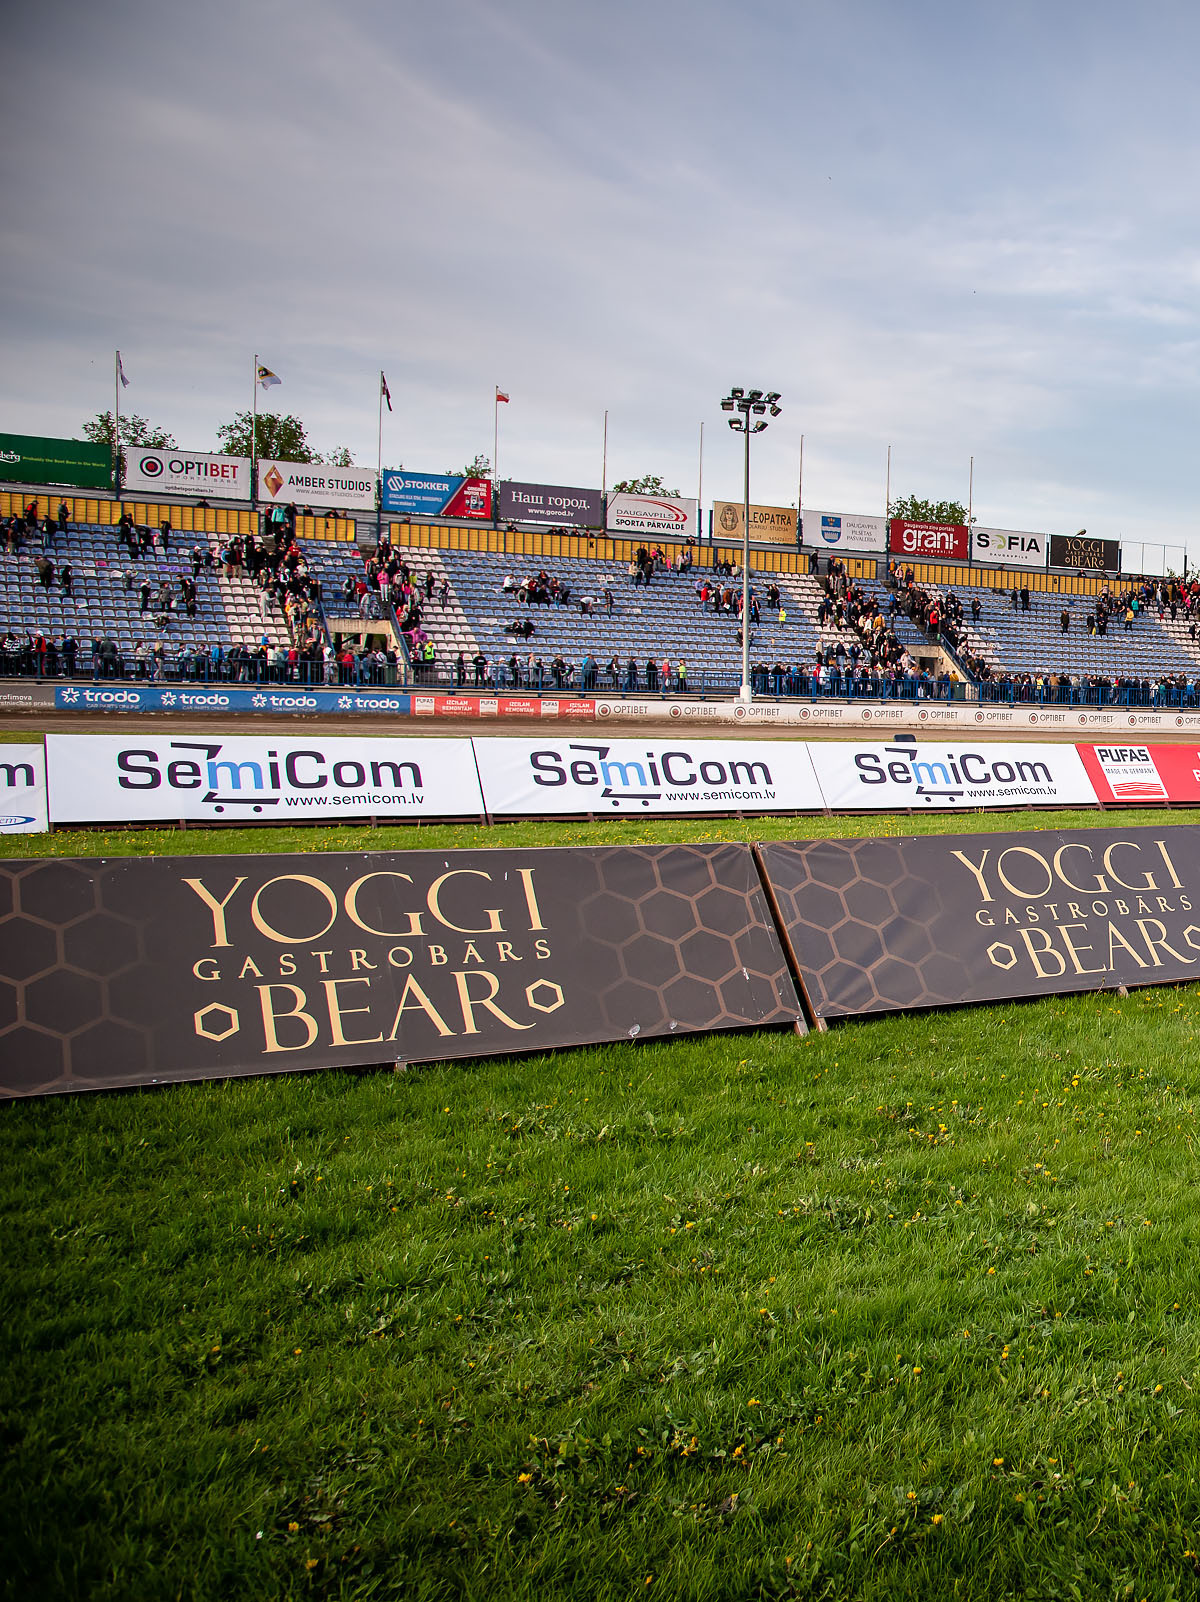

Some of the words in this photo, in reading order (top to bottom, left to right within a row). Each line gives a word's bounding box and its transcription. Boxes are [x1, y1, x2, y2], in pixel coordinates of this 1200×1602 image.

[169, 460, 239, 479] OPTIBET
[170, 474, 208, 482] SPORTA
[288, 475, 325, 489] AMBER
[327, 479, 372, 492] STUDIOS
[405, 480, 449, 492] STOKKER
[511, 490, 544, 504] Наш
[548, 496, 591, 510] город.
[528, 508, 575, 517] www.gorod.lv
[616, 509, 674, 519] DAUGAVPILS
[615, 519, 645, 527] SPORTA
[846, 522, 878, 530] DAUGAVPILS
[904, 522, 929, 530] Daugavpils
[902, 529, 954, 552] grani
[1065, 538, 1105, 553] YOGGI
[1071, 555, 1099, 568] BEAR
[83, 690, 141, 703] trodo
[179, 693, 230, 705] trodo
[270, 695, 317, 707] trodo
[355, 697, 400, 709] trodo
[613, 705, 648, 714] OPTIBET
[684, 707, 717, 716] OPTIBET
[748, 708, 780, 716] OPTIBET
[812, 709, 843, 717] OPTIBET
[874, 710, 903, 718] OPTIBET
[930, 711, 958, 719] OPTIBET
[986, 713, 1013, 721] OPTIBET
[1039, 714, 1065, 722] OPTIBET
[1089, 715, 1113, 723] OPTIBET
[1138, 716, 1162, 724] OPTIBET
[1098, 748, 1150, 762] PUFAS
[117, 749, 423, 790] SemiCom
[530, 750, 773, 787] SemiCom
[854, 753, 1053, 784] SemiCom
[665, 789, 776, 801] www.semicom.lv
[967, 785, 1057, 798] www.semicom.lv
[285, 792, 424, 806] www.semicom.lv
[950, 840, 1185, 902] YOGGI
[181, 868, 548, 948] YOGGI
[974, 895, 1193, 927] GASTROBĀRS
[1016, 918, 1198, 979] BEAR
[192, 939, 552, 981] GASTROBĀRS
[252, 970, 537, 1054] BEAR
